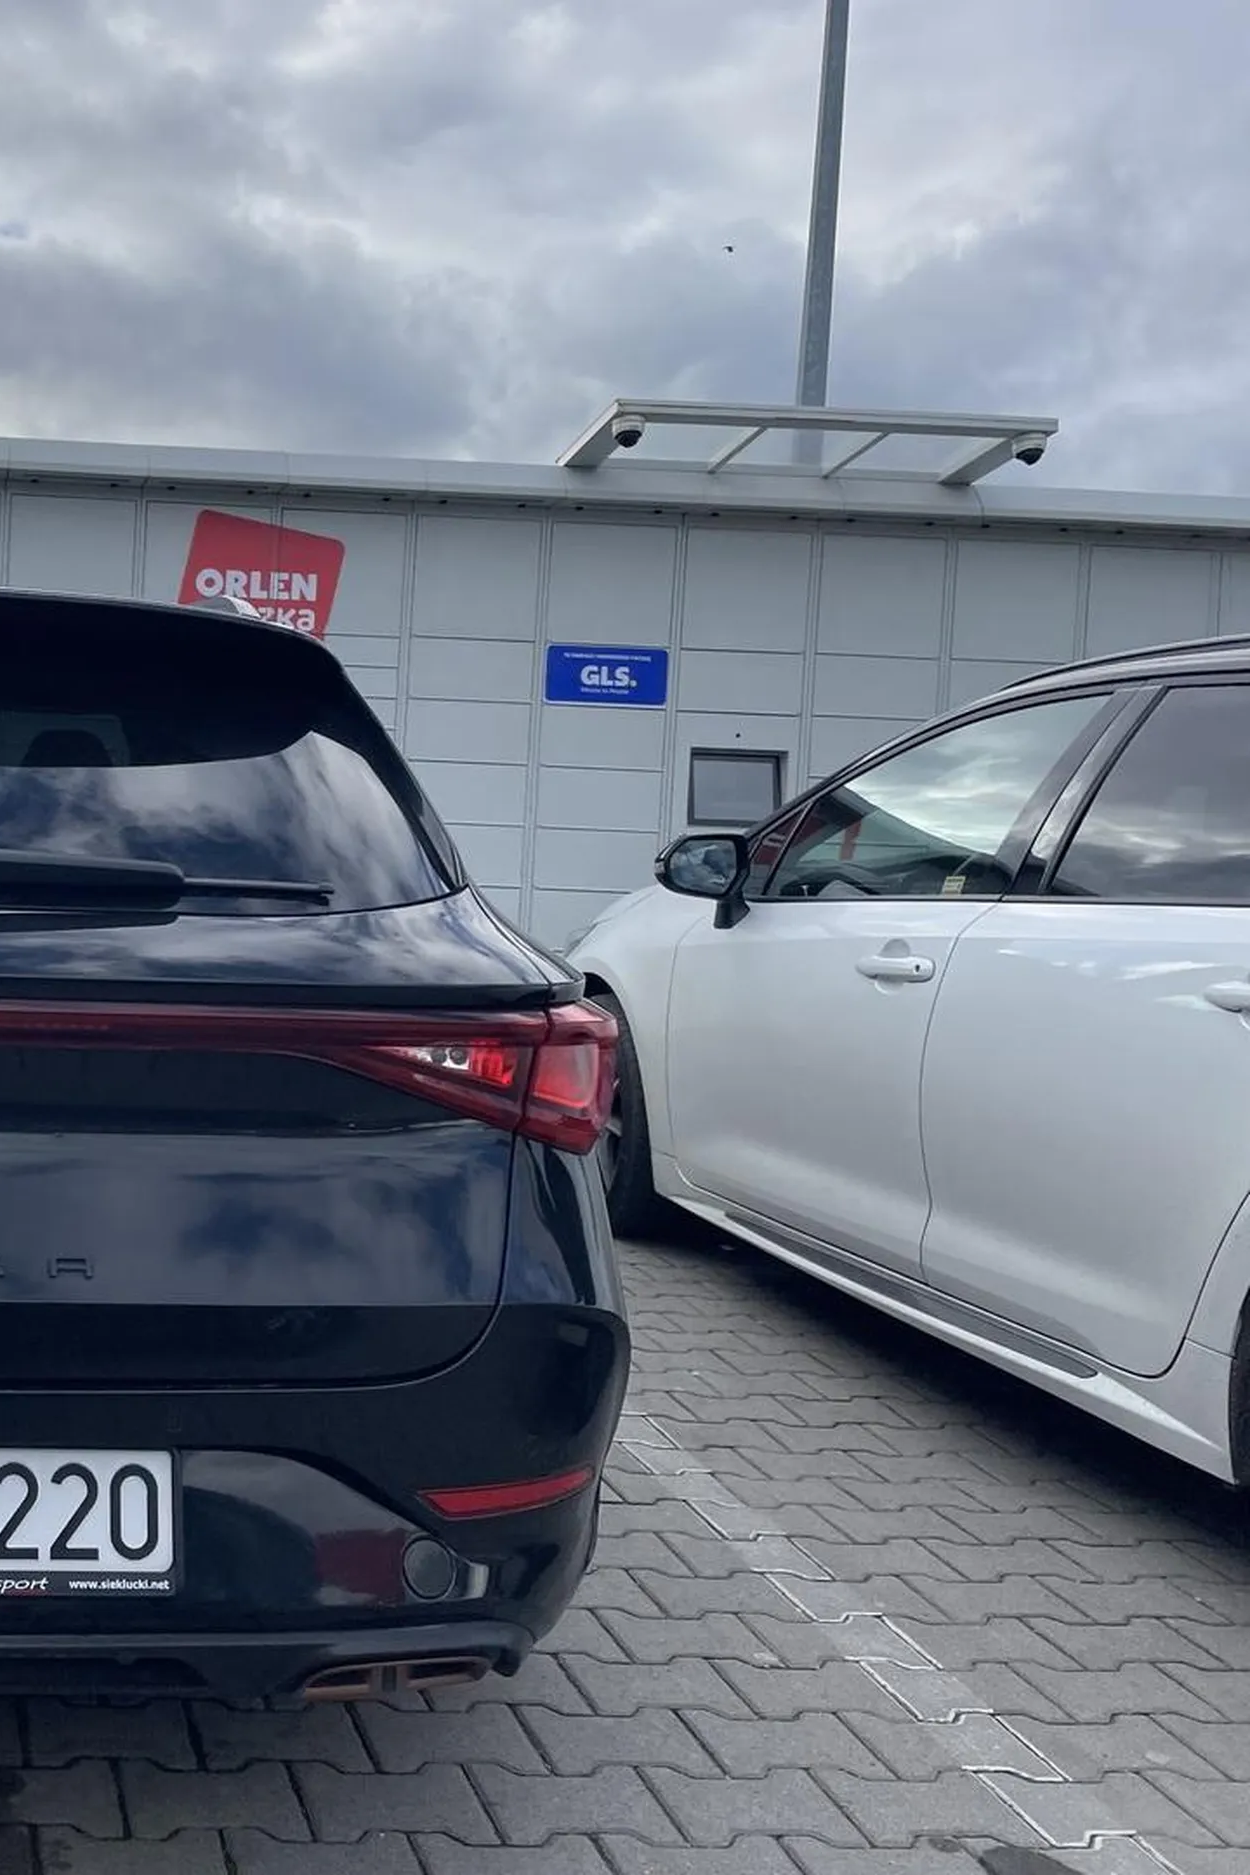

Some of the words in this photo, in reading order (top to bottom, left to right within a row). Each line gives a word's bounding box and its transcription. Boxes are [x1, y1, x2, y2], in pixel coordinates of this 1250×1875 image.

[195, 567, 318, 602] ORLEN
[257, 606, 316, 632] zka
[68, 1578, 170, 1591] www.sieklucki.net
